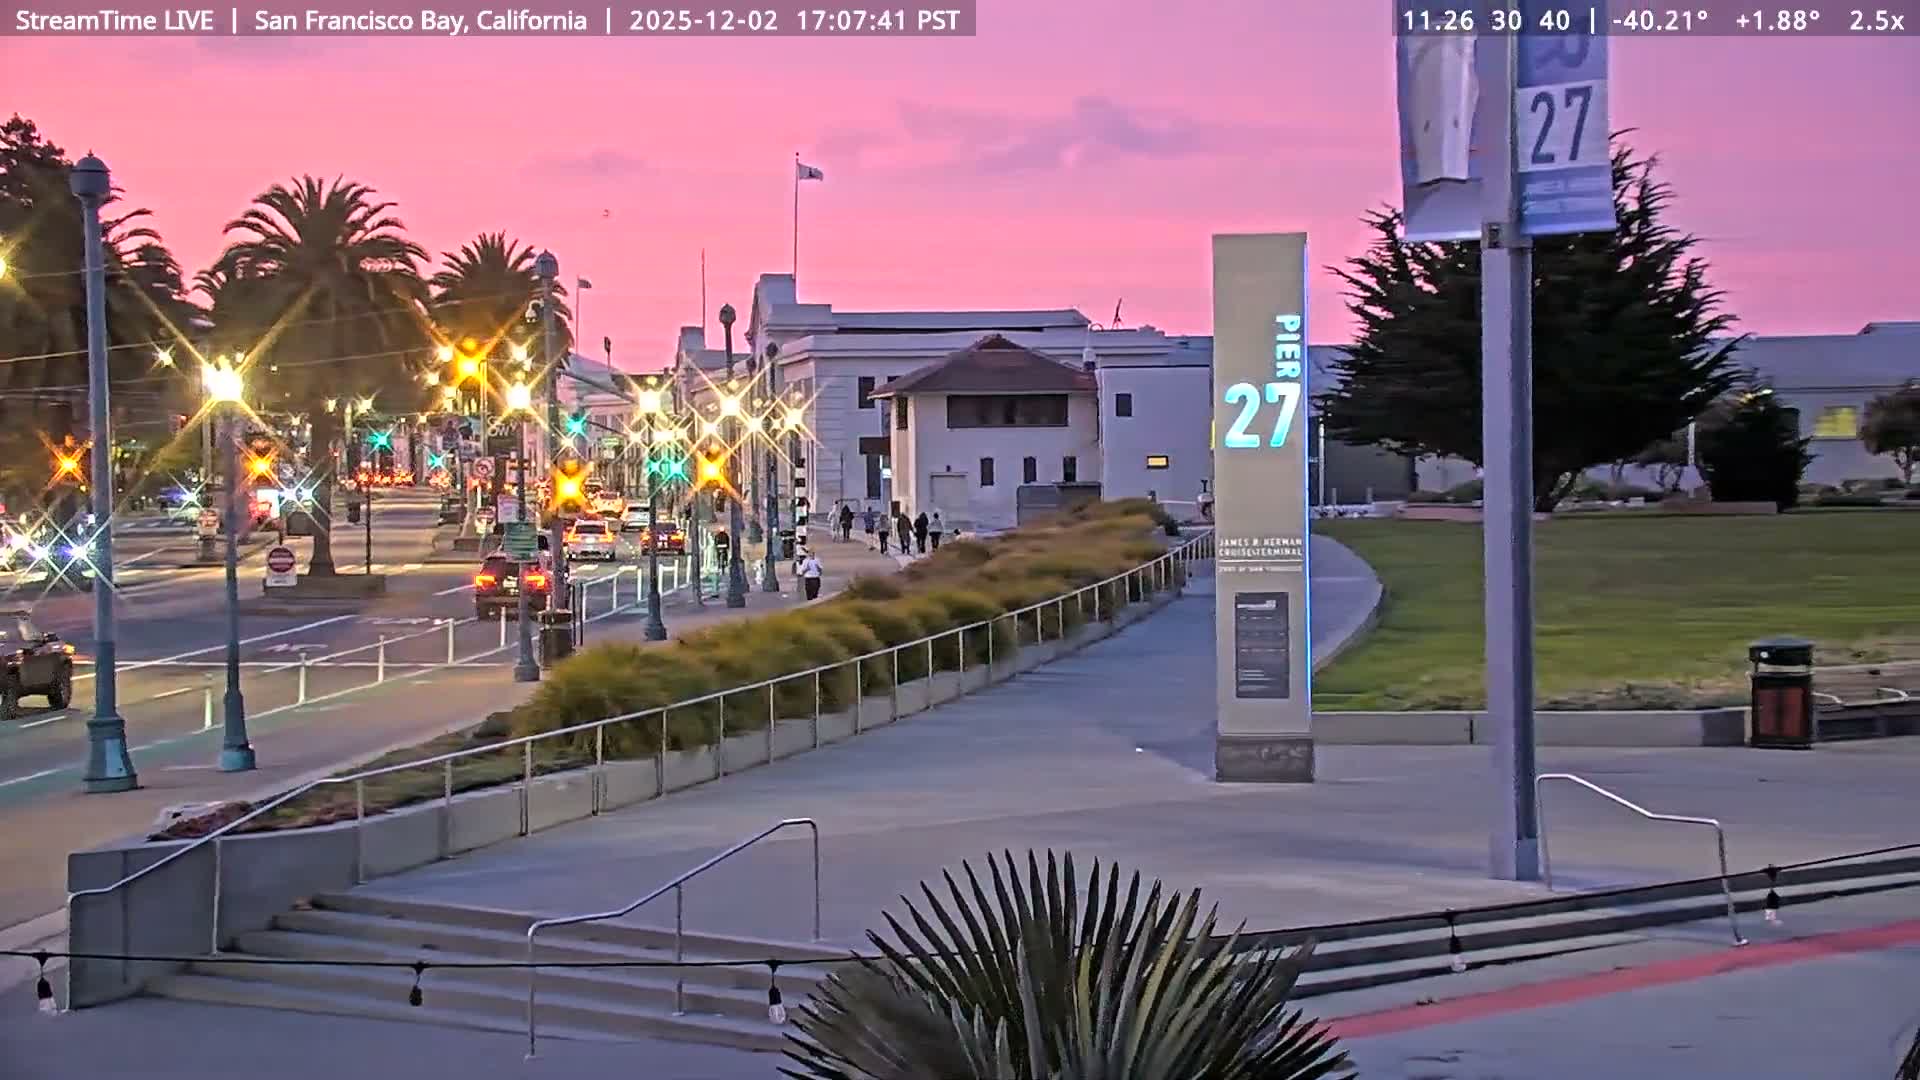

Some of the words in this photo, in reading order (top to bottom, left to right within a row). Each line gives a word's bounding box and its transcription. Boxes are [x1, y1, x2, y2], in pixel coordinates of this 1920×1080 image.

[1530, 85, 1593, 164] 27
[1275, 314, 1301, 378] PIER
[1224, 382, 1301, 448] 27
